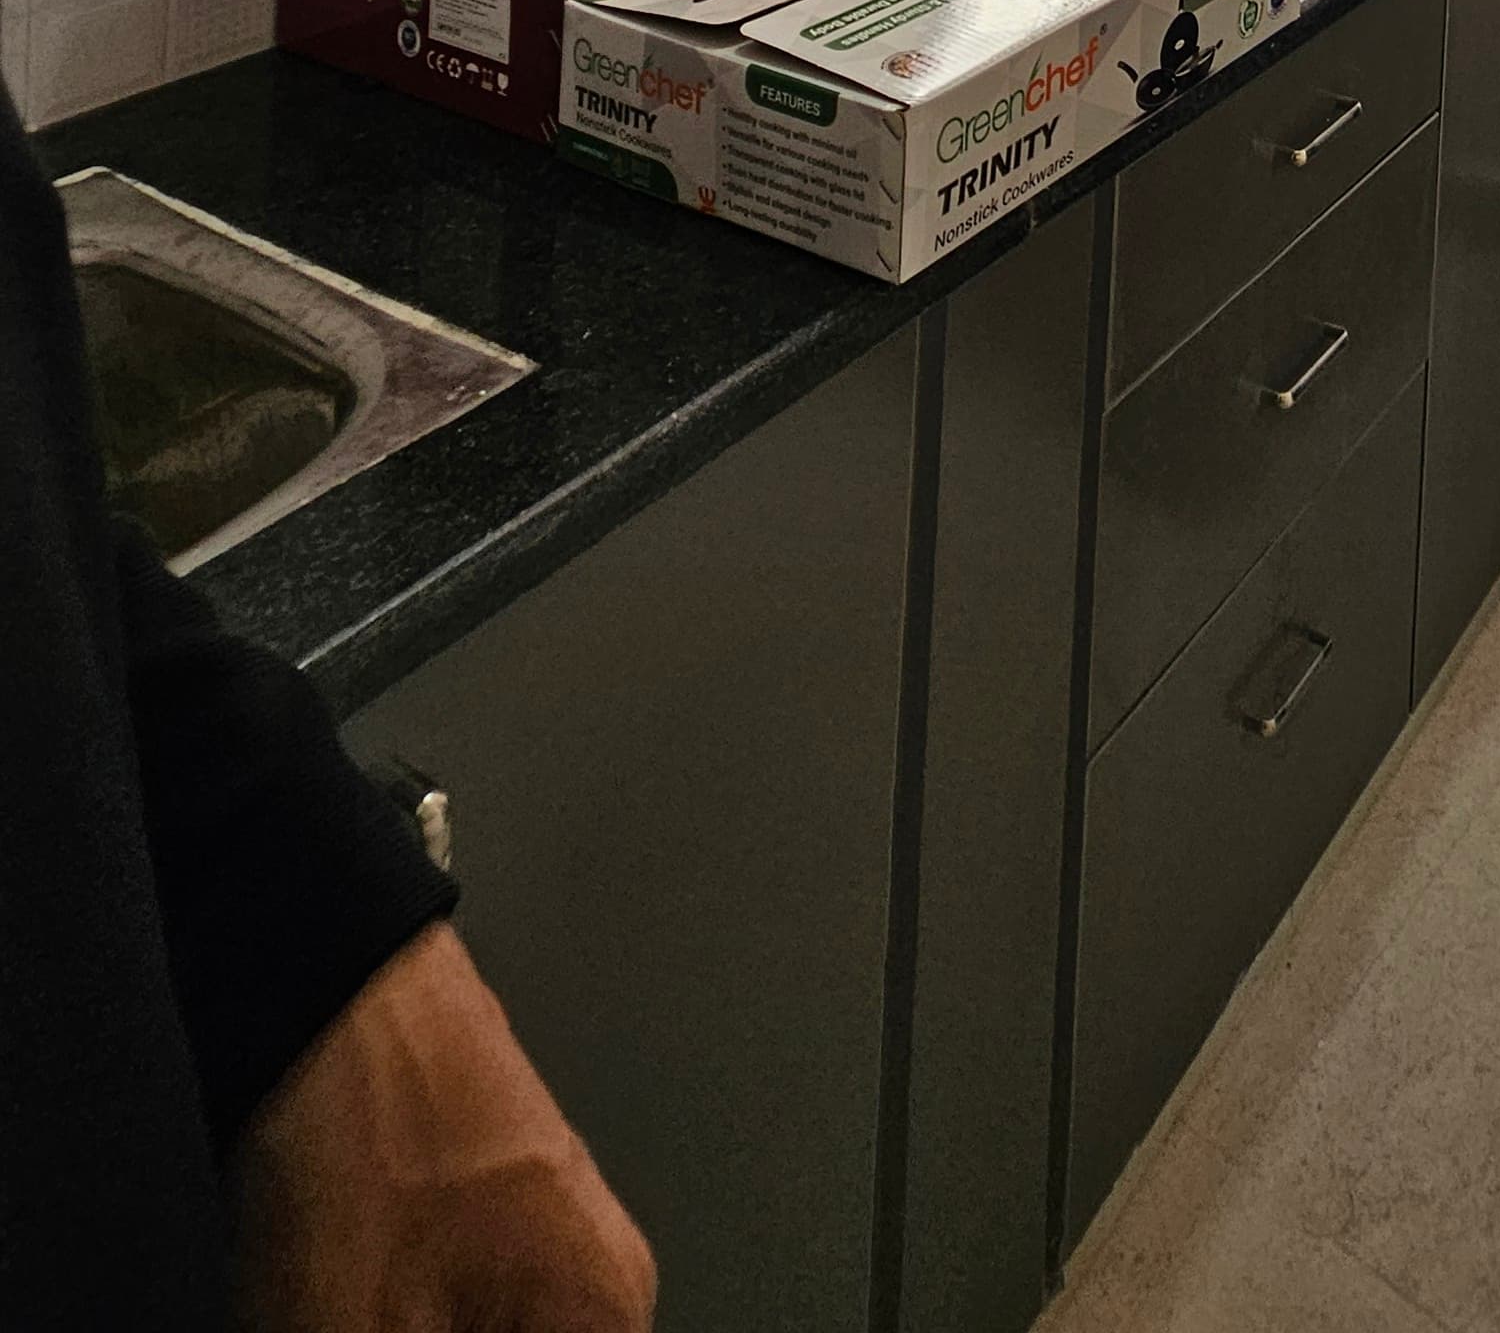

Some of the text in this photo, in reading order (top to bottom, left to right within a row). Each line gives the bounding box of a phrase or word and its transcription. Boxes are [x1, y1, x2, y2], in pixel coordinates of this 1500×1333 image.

[573, 37, 707, 116] Greenchef
[575, 84, 659, 134] TRINITY
[760, 84, 821, 117] FEATURES
[936, 35, 1099, 165] Greenchef
[934, 149, 1075, 252] Nonstick Cookwares
[938, 114, 1061, 217] TRINITY
